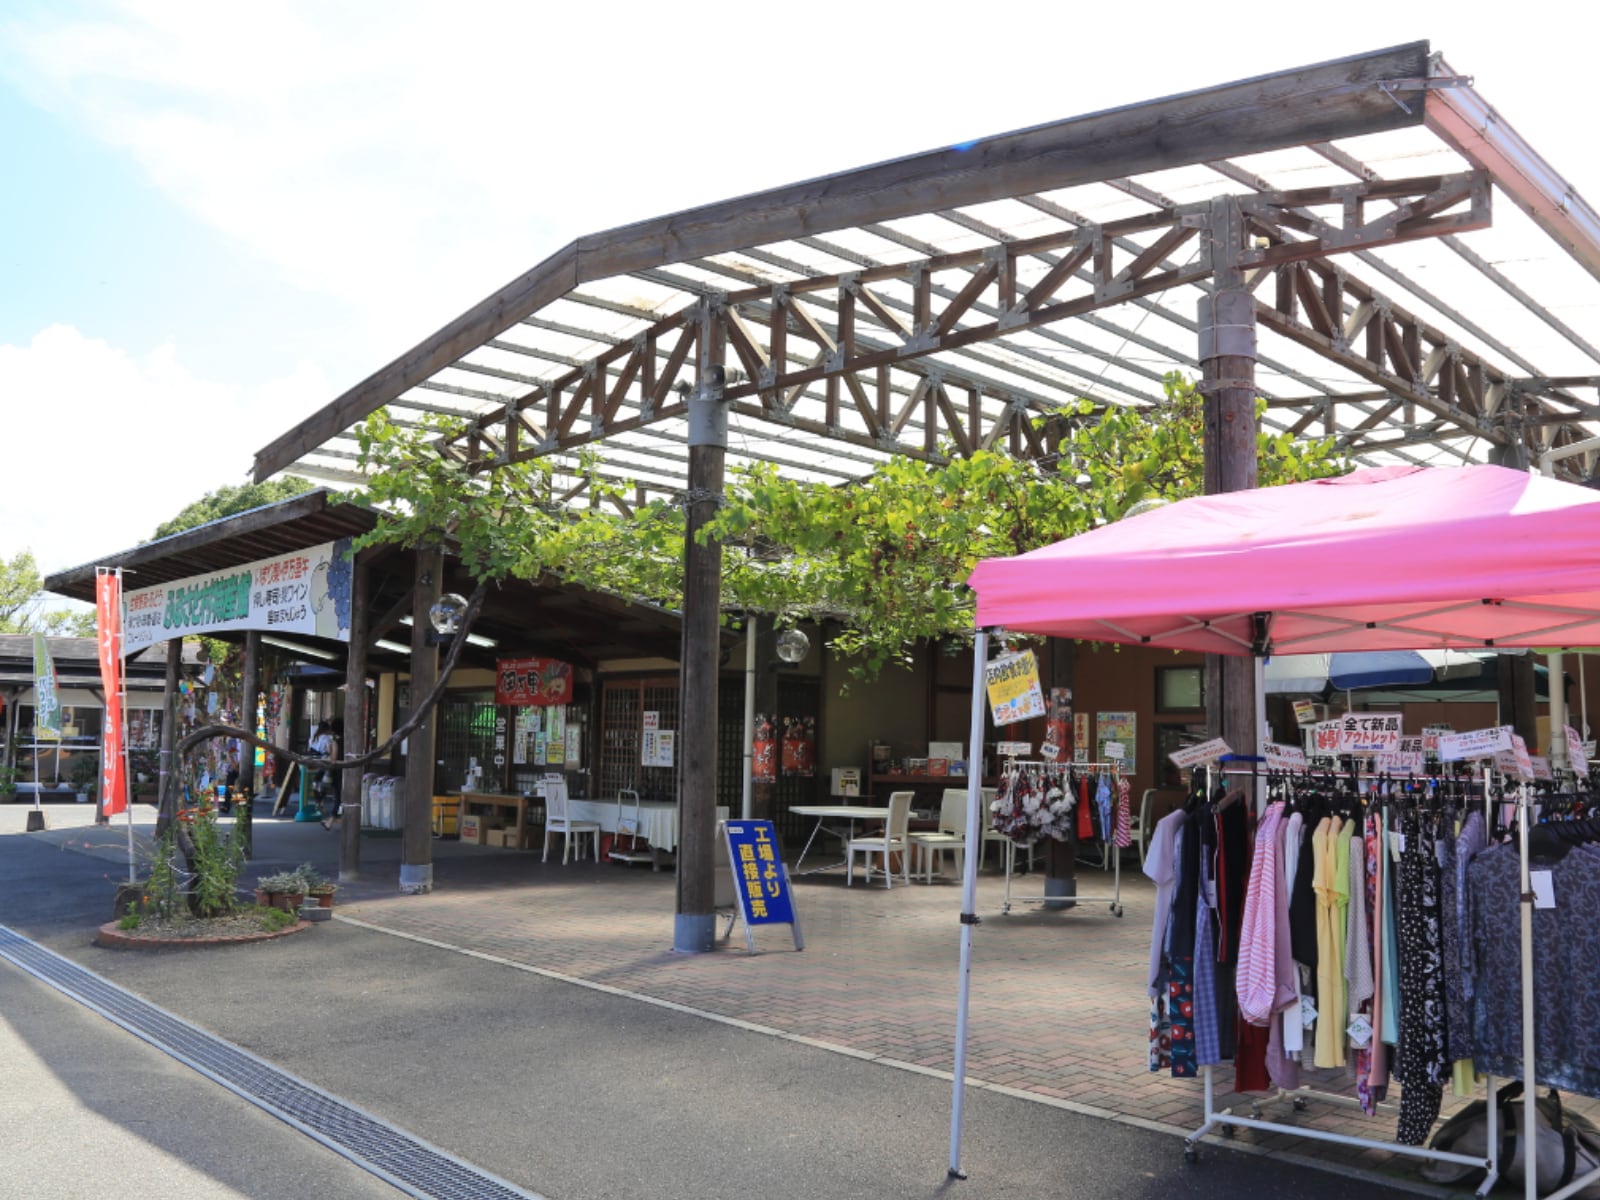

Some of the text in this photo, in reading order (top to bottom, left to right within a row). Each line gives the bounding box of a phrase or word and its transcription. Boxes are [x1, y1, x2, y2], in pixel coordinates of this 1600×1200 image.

[1344, 717, 1399, 731] 全て新品
[1344, 731, 1397, 744] アウトレット
[493, 716, 506, 768] 営業中
[1379, 753, 1421, 766] アウトレット
[752, 826, 780, 898] 工場より
[737, 843, 768, 918] 直接販売
